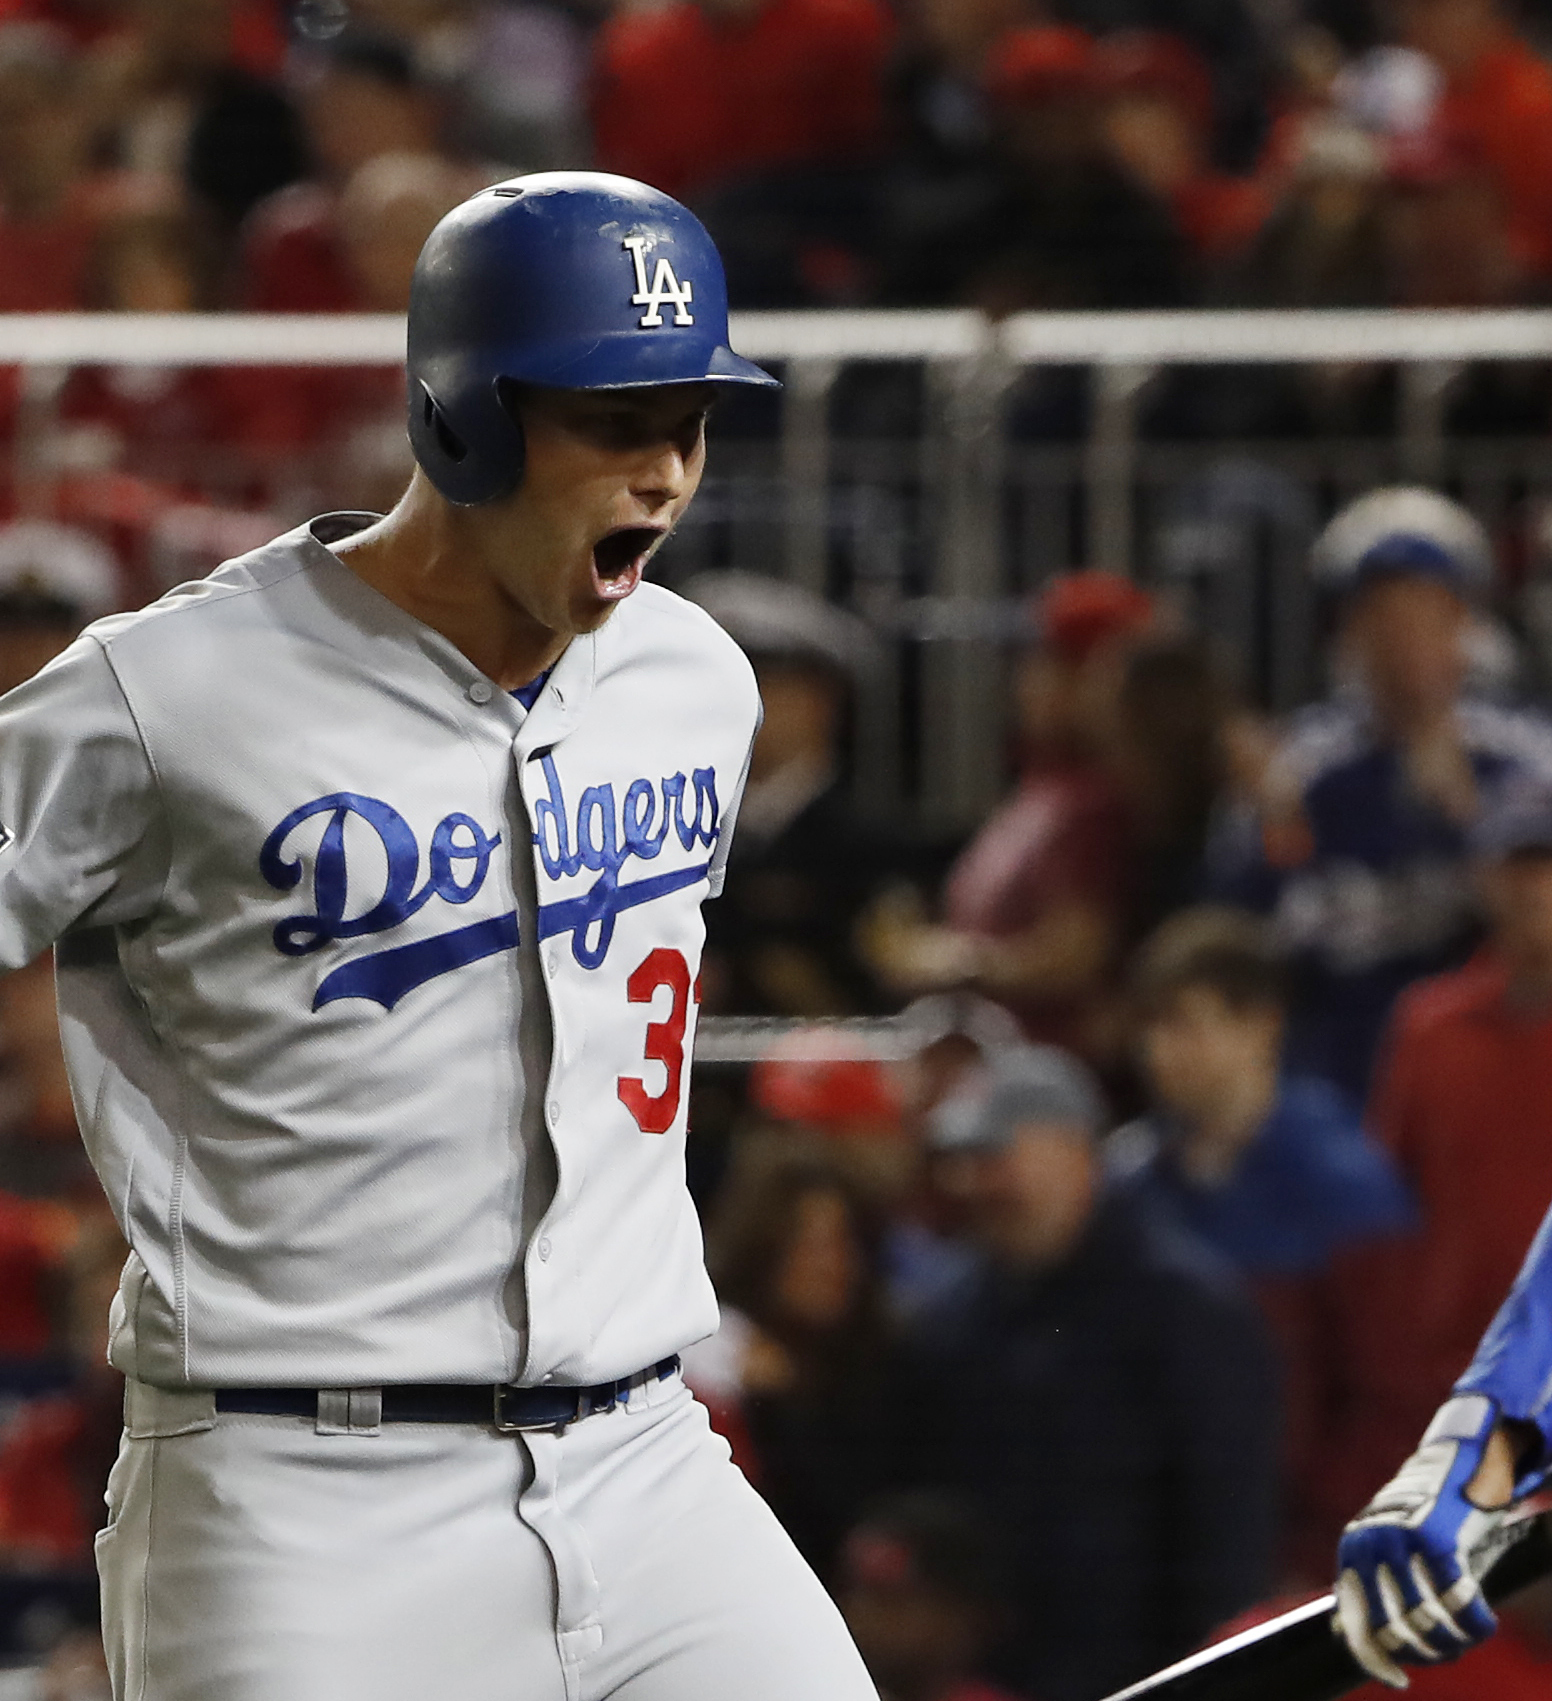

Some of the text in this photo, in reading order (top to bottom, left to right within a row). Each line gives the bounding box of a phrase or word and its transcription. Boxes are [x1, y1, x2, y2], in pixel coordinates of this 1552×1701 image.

[623, 236, 695, 327] LA
[259, 755, 721, 969] Dodgers
[616, 946, 702, 1135] 3
